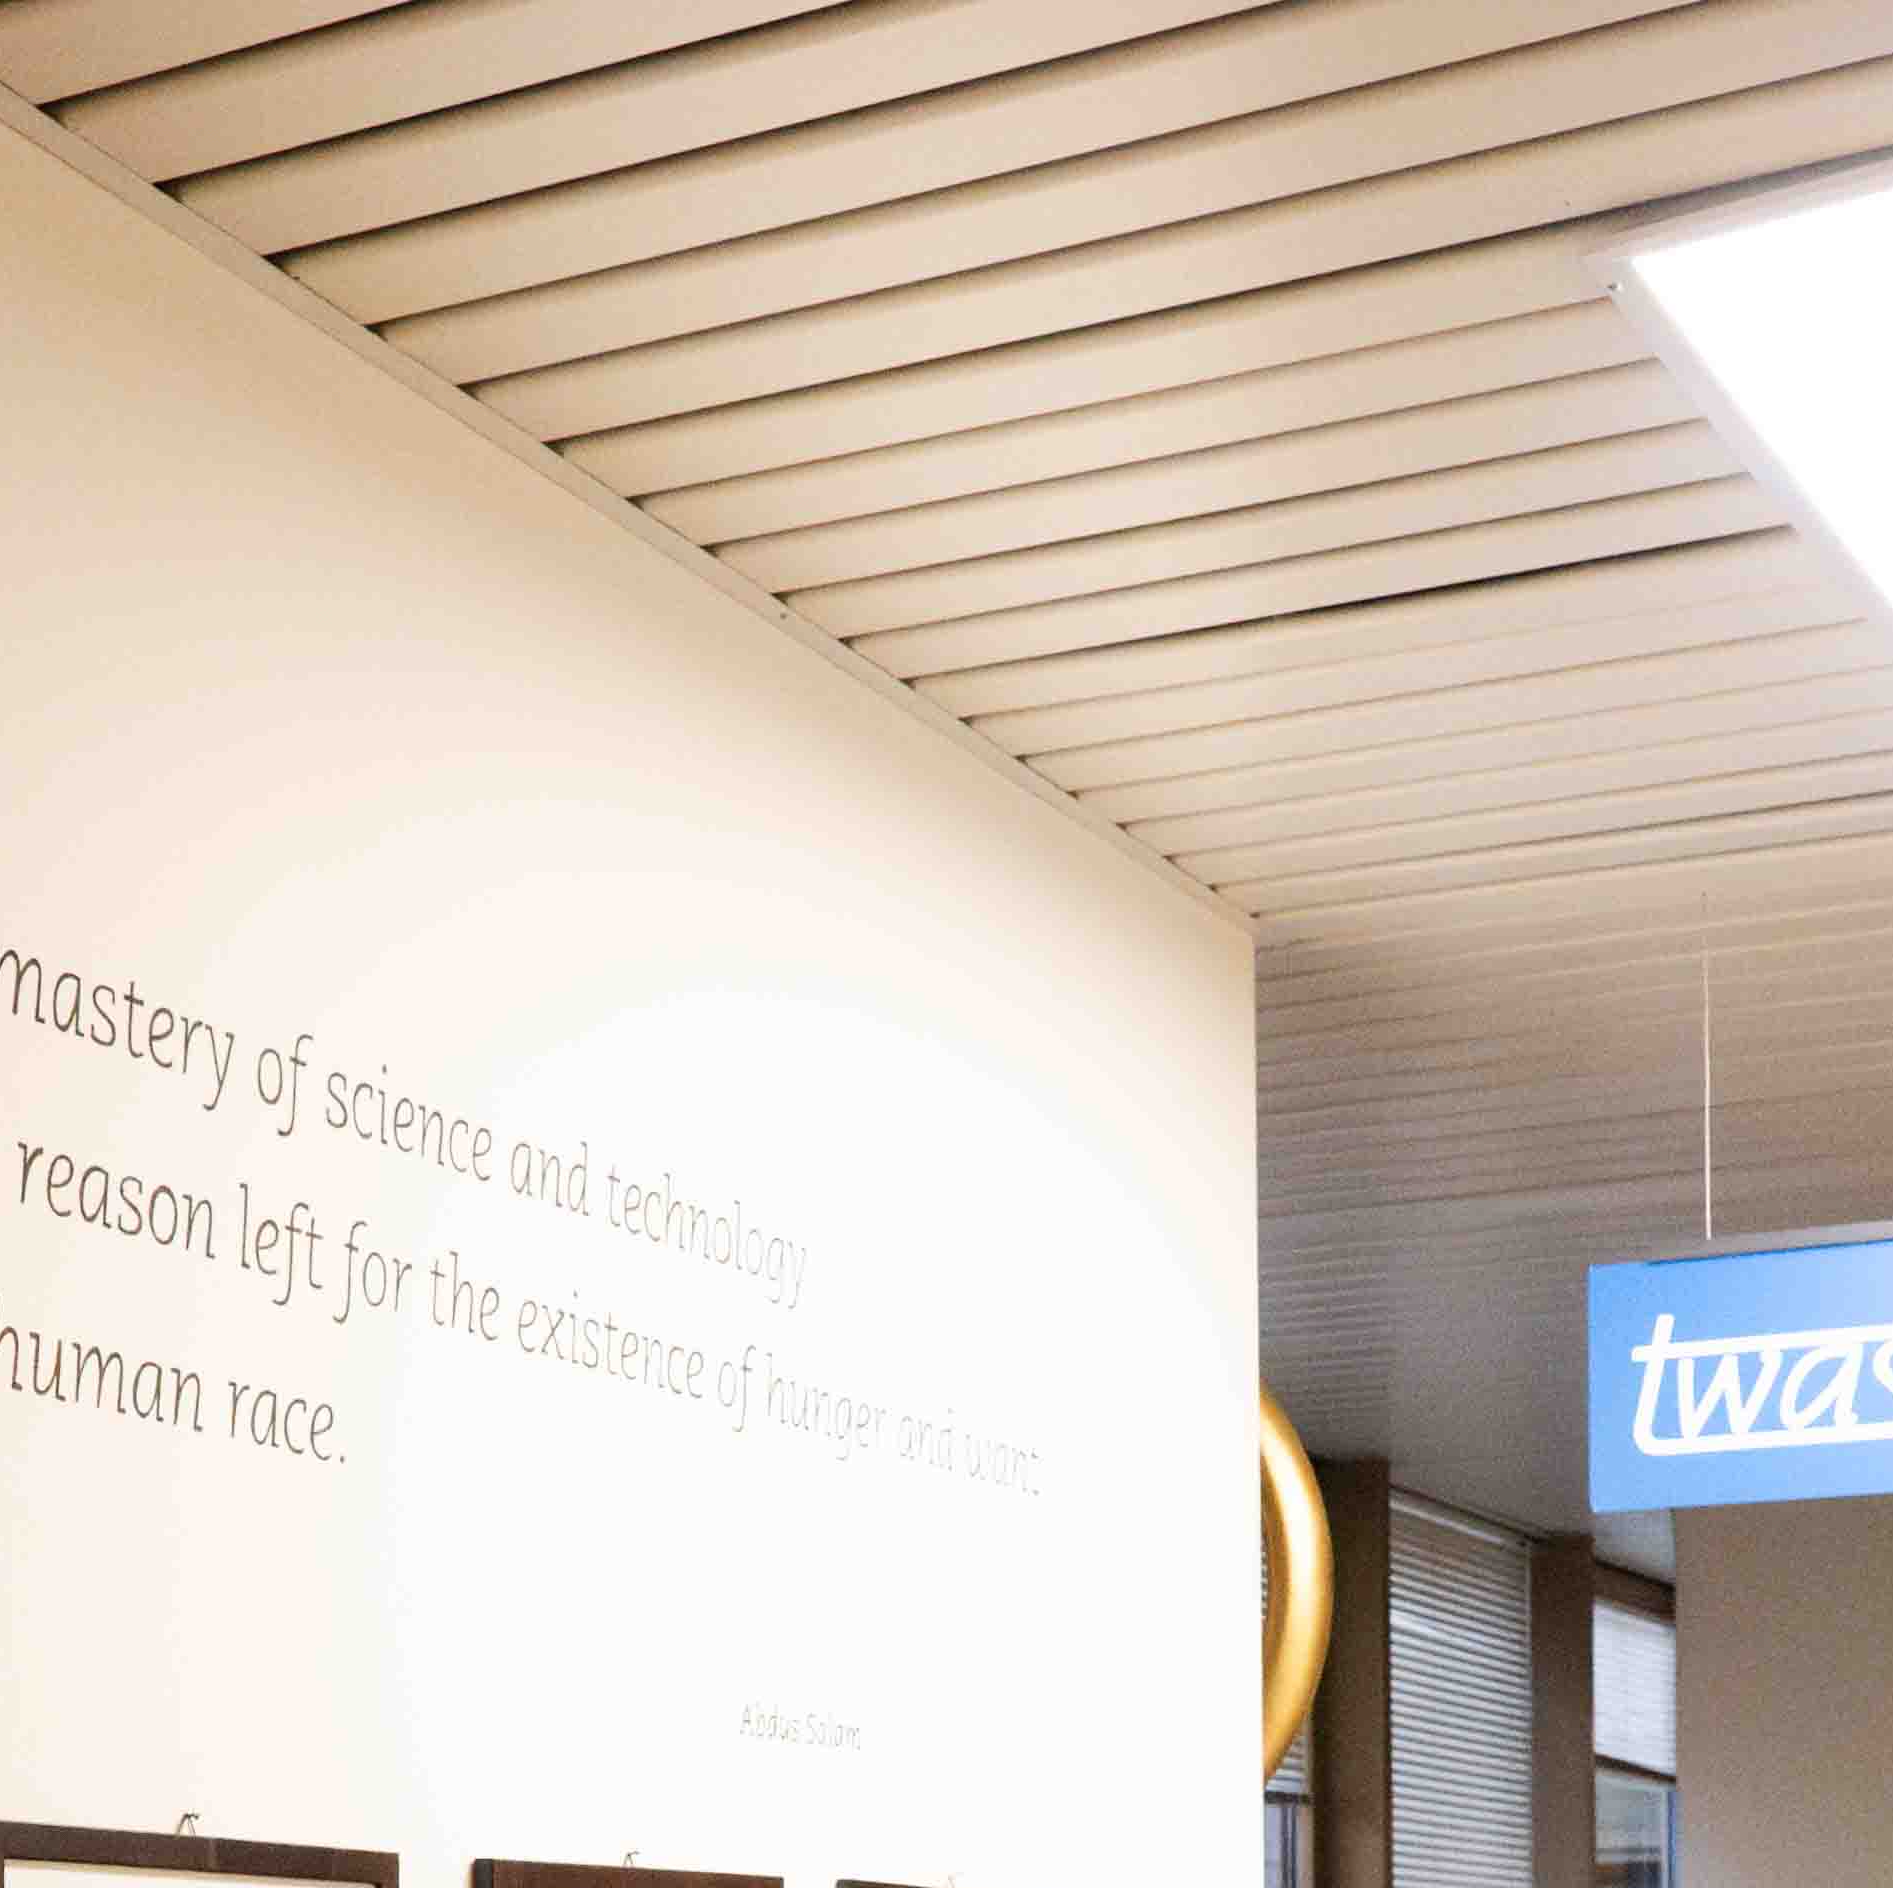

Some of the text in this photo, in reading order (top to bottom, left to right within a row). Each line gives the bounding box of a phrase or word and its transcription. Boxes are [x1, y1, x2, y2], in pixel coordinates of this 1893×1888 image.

[17, 1140, 215, 1262] reason
[239, 1183, 323, 1306] left
[333, 1221, 412, 1323] for
[430, 1251, 499, 1342] the
[517, 1290, 704, 1400] existence
[717, 1345, 758, 1433] of
[765, 1351, 887, 1461] hunger
[898, 1410, 953, 1471] and
[257, 1036, 313, 1136] of
[326, 1066, 492, 1183] science
[511, 1141, 589, 1217] and
[608, 1163, 807, 1309] technology
[228, 1375, 346, 1464] race.
